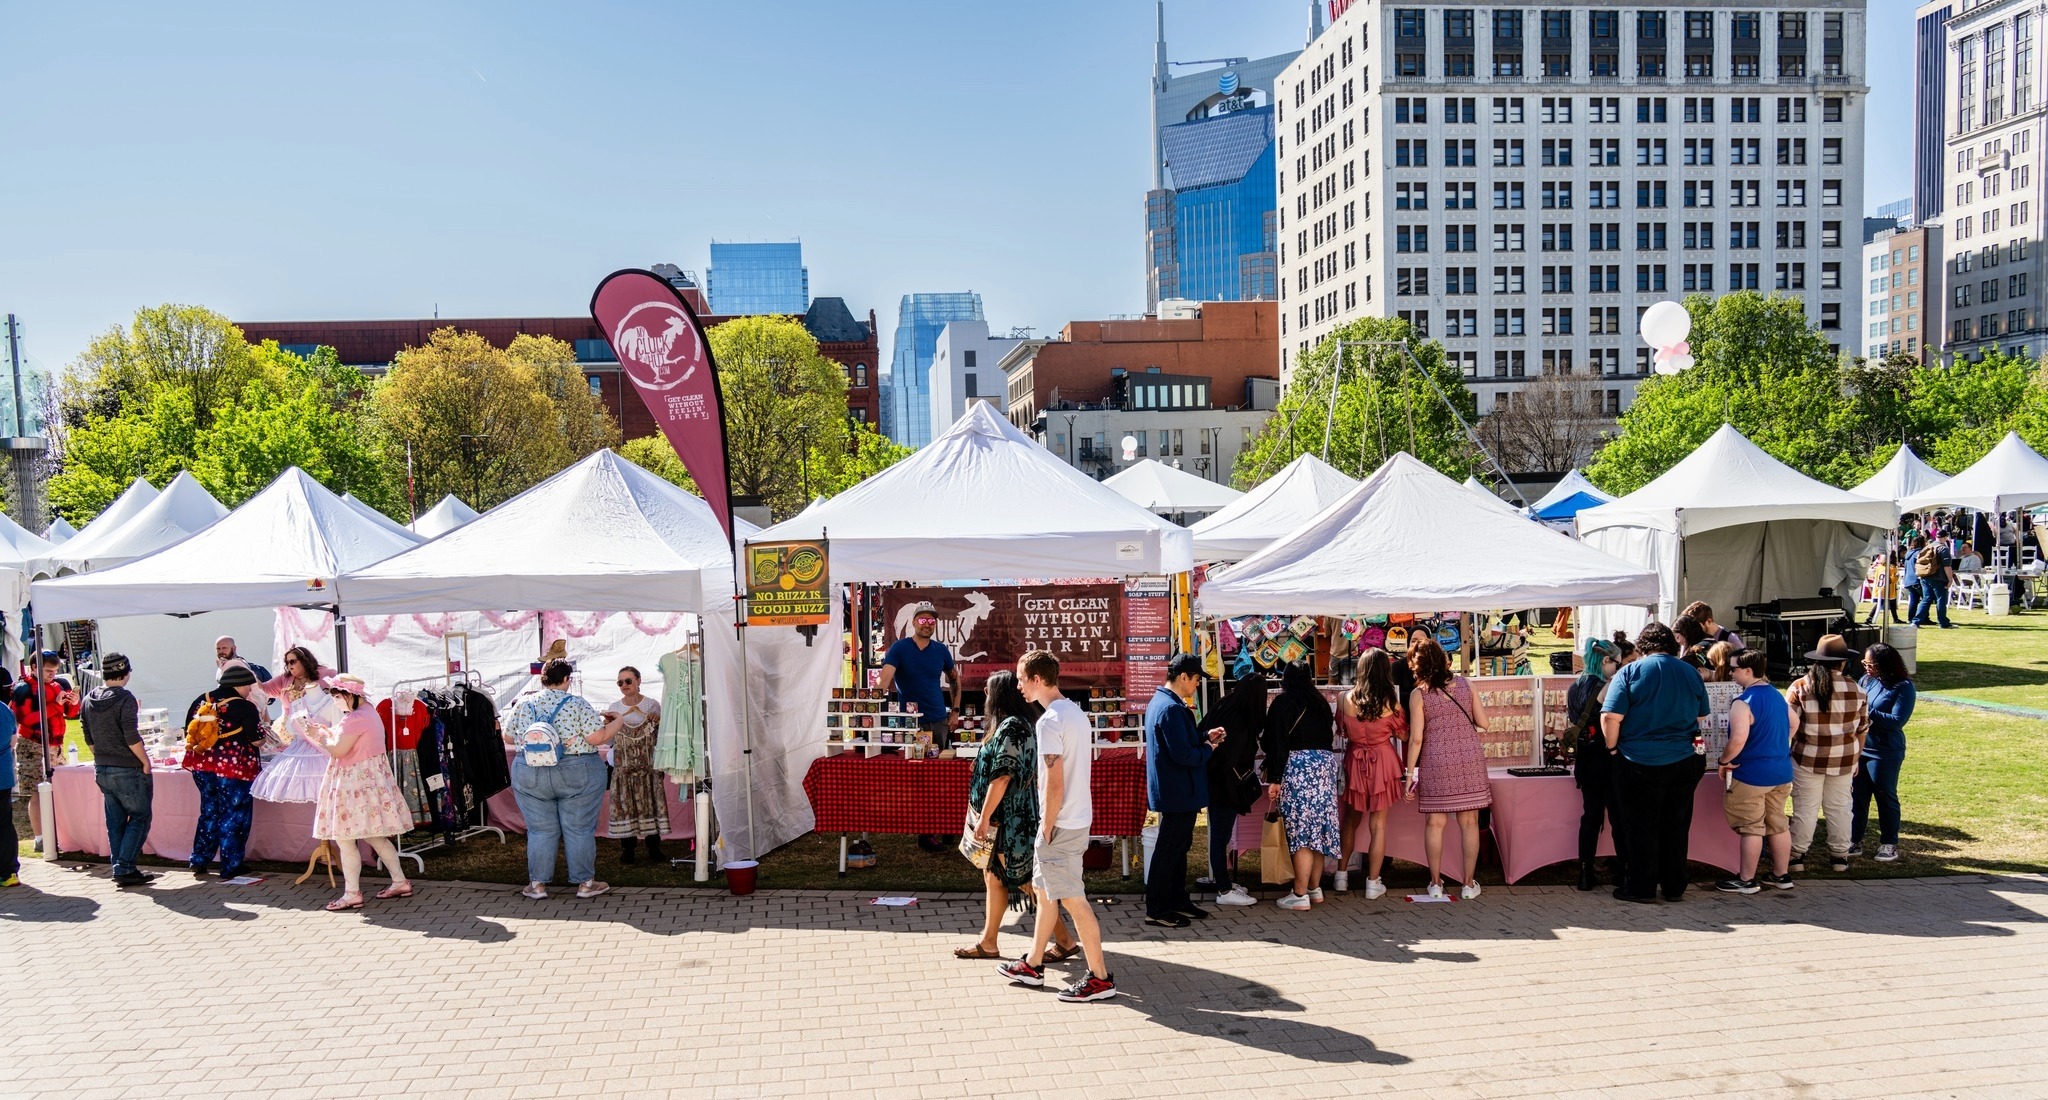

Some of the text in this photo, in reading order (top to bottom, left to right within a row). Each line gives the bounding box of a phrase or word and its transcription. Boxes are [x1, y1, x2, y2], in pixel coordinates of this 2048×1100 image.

[1219, 96, 1243, 112] at&t
[637, 334, 671, 355] CLUCK
[648, 353, 665, 368] HUT
[668, 400, 704, 409] WITHOUT
[682, 394, 704, 402] CLEAN
[670, 411, 706, 420] DIRTY
[755, 590, 821, 601] NO BUZZ IS
[753, 603, 825, 614] GOOD BUZZ
[1024, 598, 1109, 611] GET CLEAN
[1024, 612, 1110, 625] WITHOUT
[1024, 626, 1111, 639] FEELIN'
[1025, 640, 1111, 653] DIRTY
